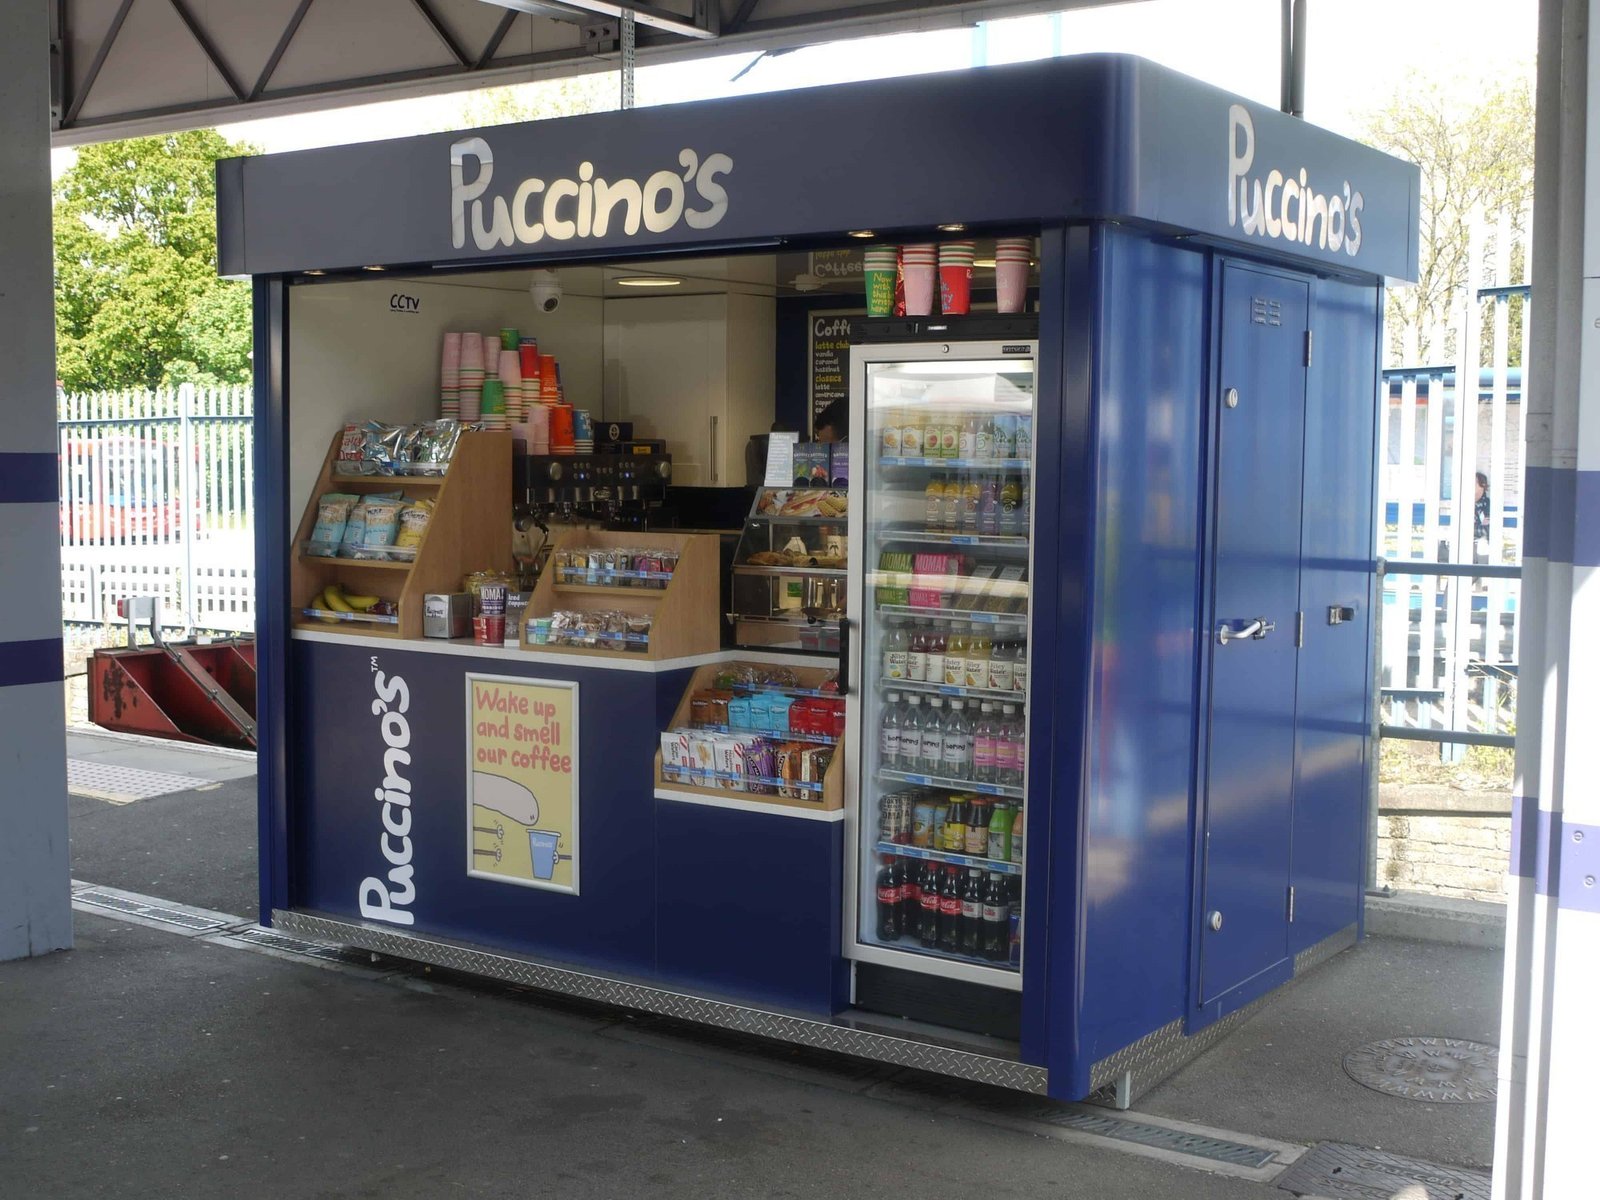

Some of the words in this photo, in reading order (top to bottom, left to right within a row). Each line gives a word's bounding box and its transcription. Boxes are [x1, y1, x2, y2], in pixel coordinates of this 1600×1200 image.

[450, 137, 734, 250] Puccino's
[1228, 104, 1364, 256] Puccino's
[390, 294, 419, 309] CCTV
[815, 318, 850, 336] Coff
[476, 686, 529, 715] Wake
[533, 700, 556, 725] up
[477, 715, 509, 740] and
[513, 721, 560, 746] smell
[477, 747, 508, 765] our
[511, 744, 572, 773] coffee
[359, 670, 416, 925] Puccino's
